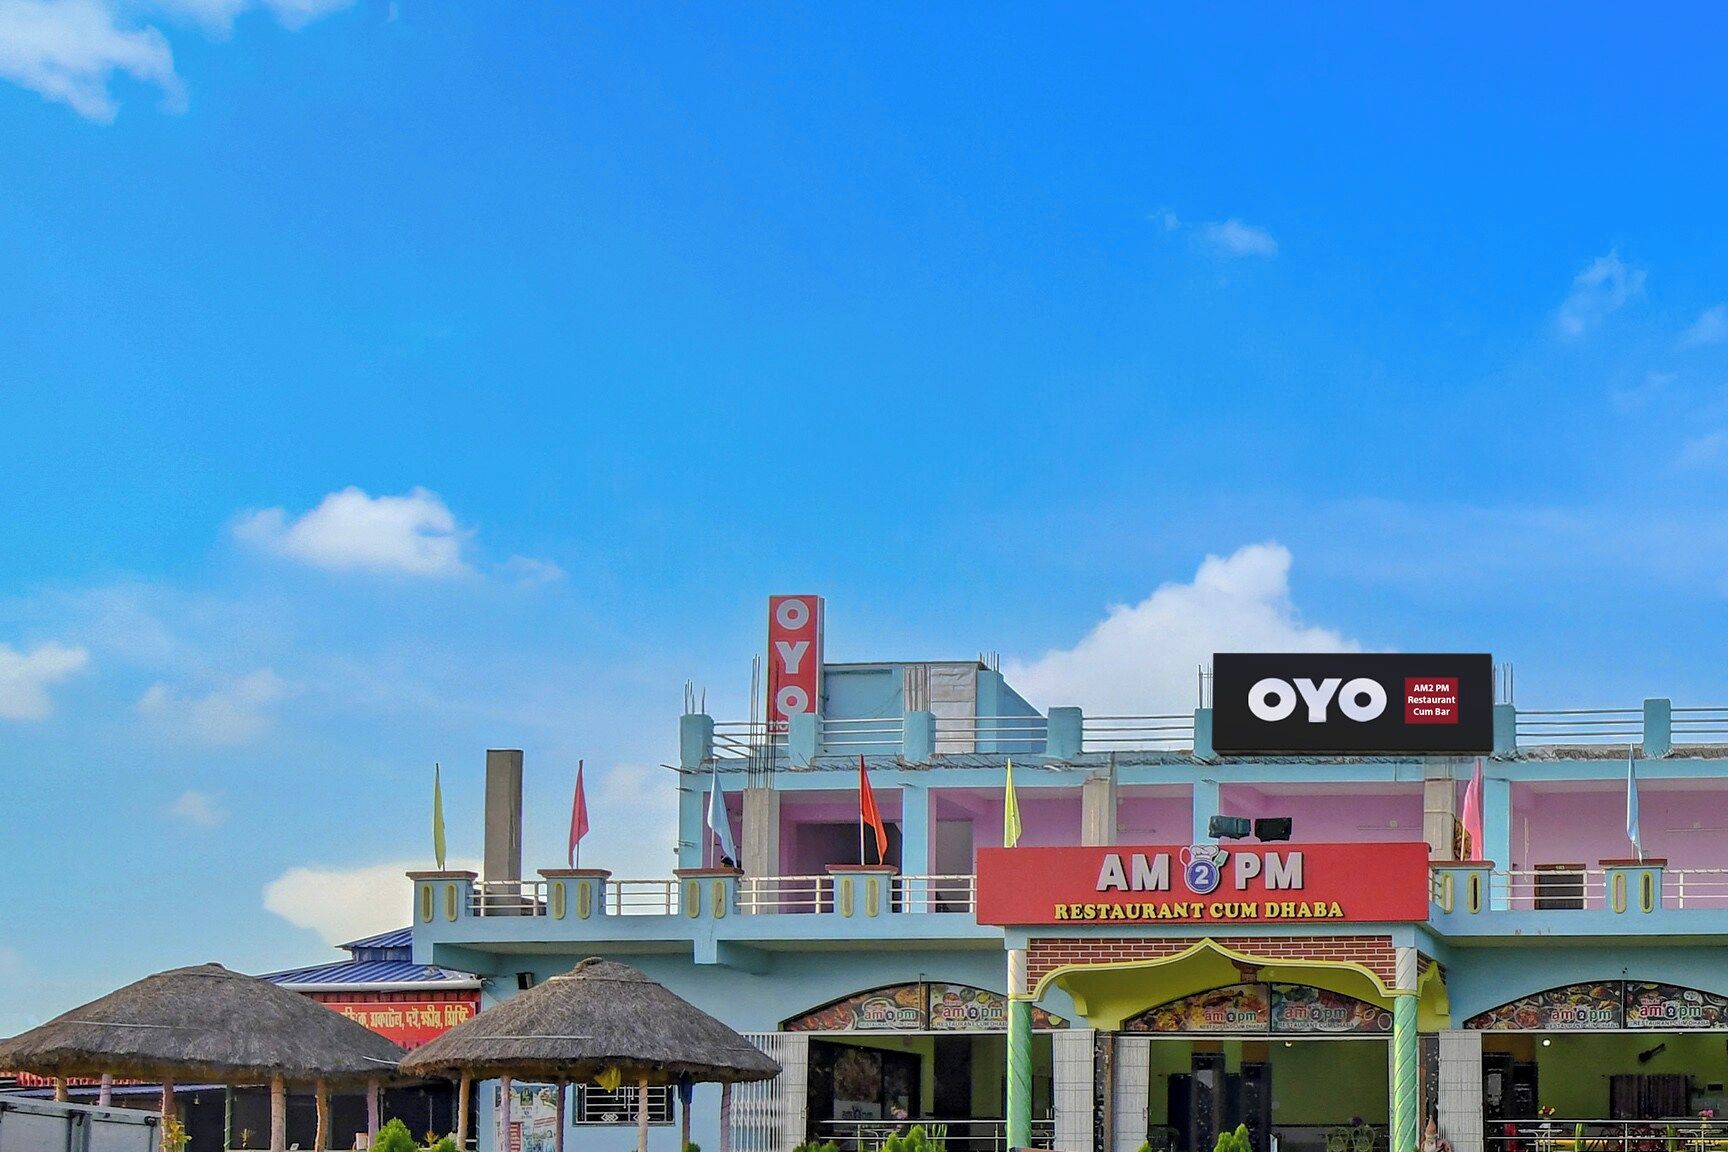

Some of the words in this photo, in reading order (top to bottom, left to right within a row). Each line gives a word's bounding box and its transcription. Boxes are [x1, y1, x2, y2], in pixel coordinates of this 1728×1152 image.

[775, 599, 810, 718] OYO
[1413, 684, 1434, 692] AM2
[1435, 684, 1449, 692] PM
[1248, 677, 1387, 723] OYO
[1407, 695, 1456, 704] Restaurant
[1413, 707, 1433, 716] Cum
[1434, 707, 1450, 716] Bar
[1096, 853, 1170, 891] AM
[1194, 865, 1210, 885] 2
[1235, 852, 1304, 890] PM
[1054, 902, 1204, 920] RESTAURANT
[1209, 902, 1257, 918] CUM
[1265, 901, 1344, 918] DHABA
[943, 1007, 965, 1017] am
[981, 1007, 1003, 1019] pm
[1284, 1007, 1306, 1018] am
[1324, 1008, 1346, 1021] pm
[1552, 1010, 1573, 1019] am
[1589, 1010, 1611, 1021] pm
[1640, 1006, 1662, 1016] am
[1679, 1006, 1701, 1018] pm
